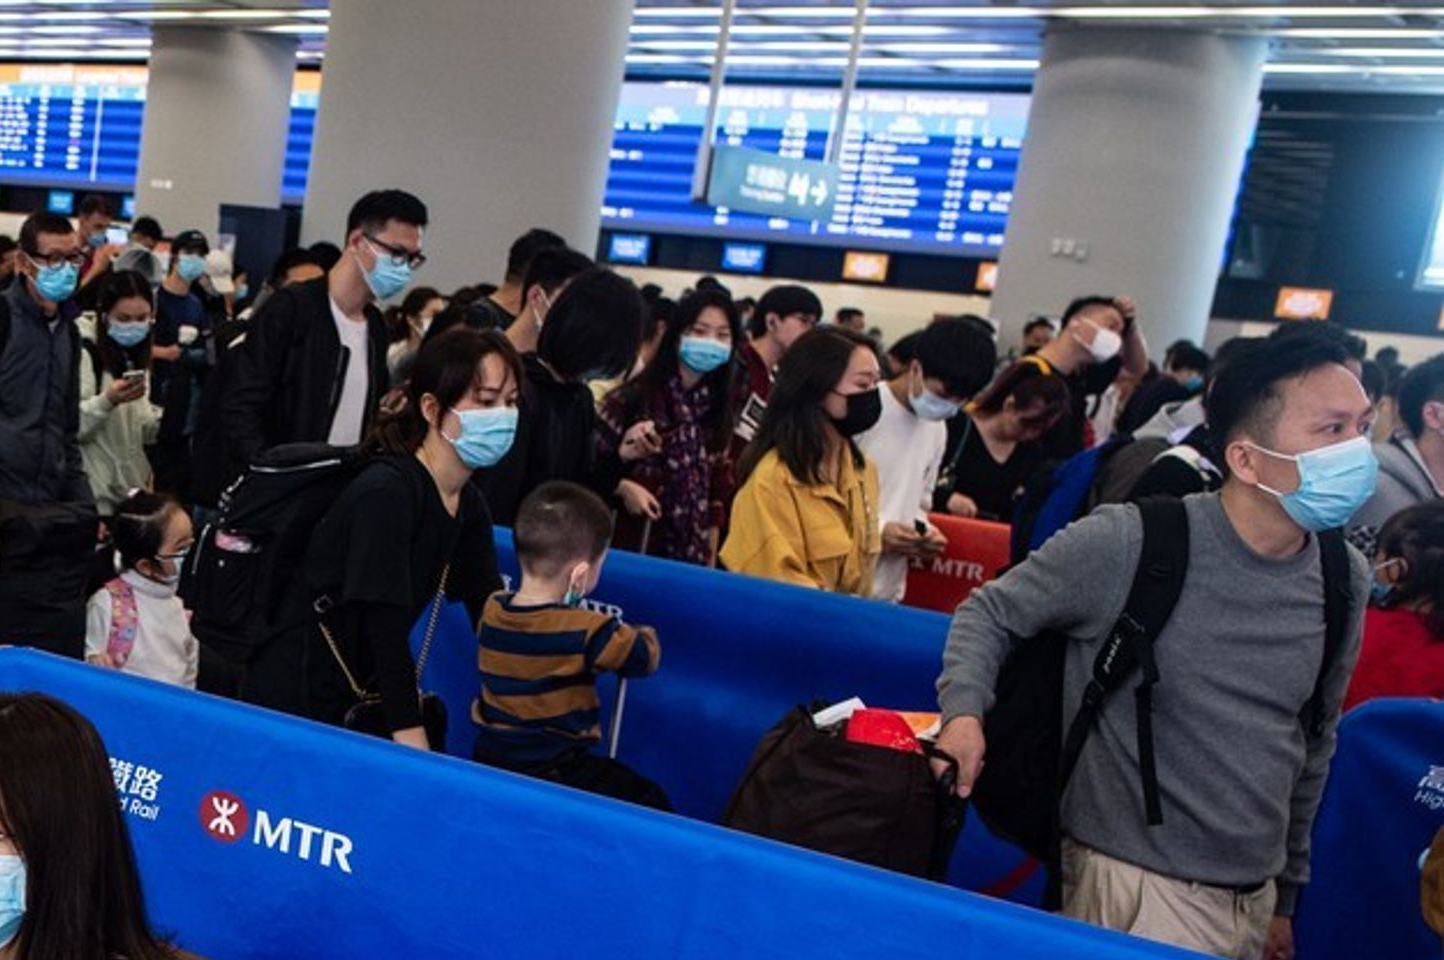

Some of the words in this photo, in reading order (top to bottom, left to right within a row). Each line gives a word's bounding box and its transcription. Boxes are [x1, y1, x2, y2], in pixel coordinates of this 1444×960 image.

[931, 557, 985, 581] MTR
[129, 799, 160, 821] Rail
[253, 809, 353, 873] MTR
